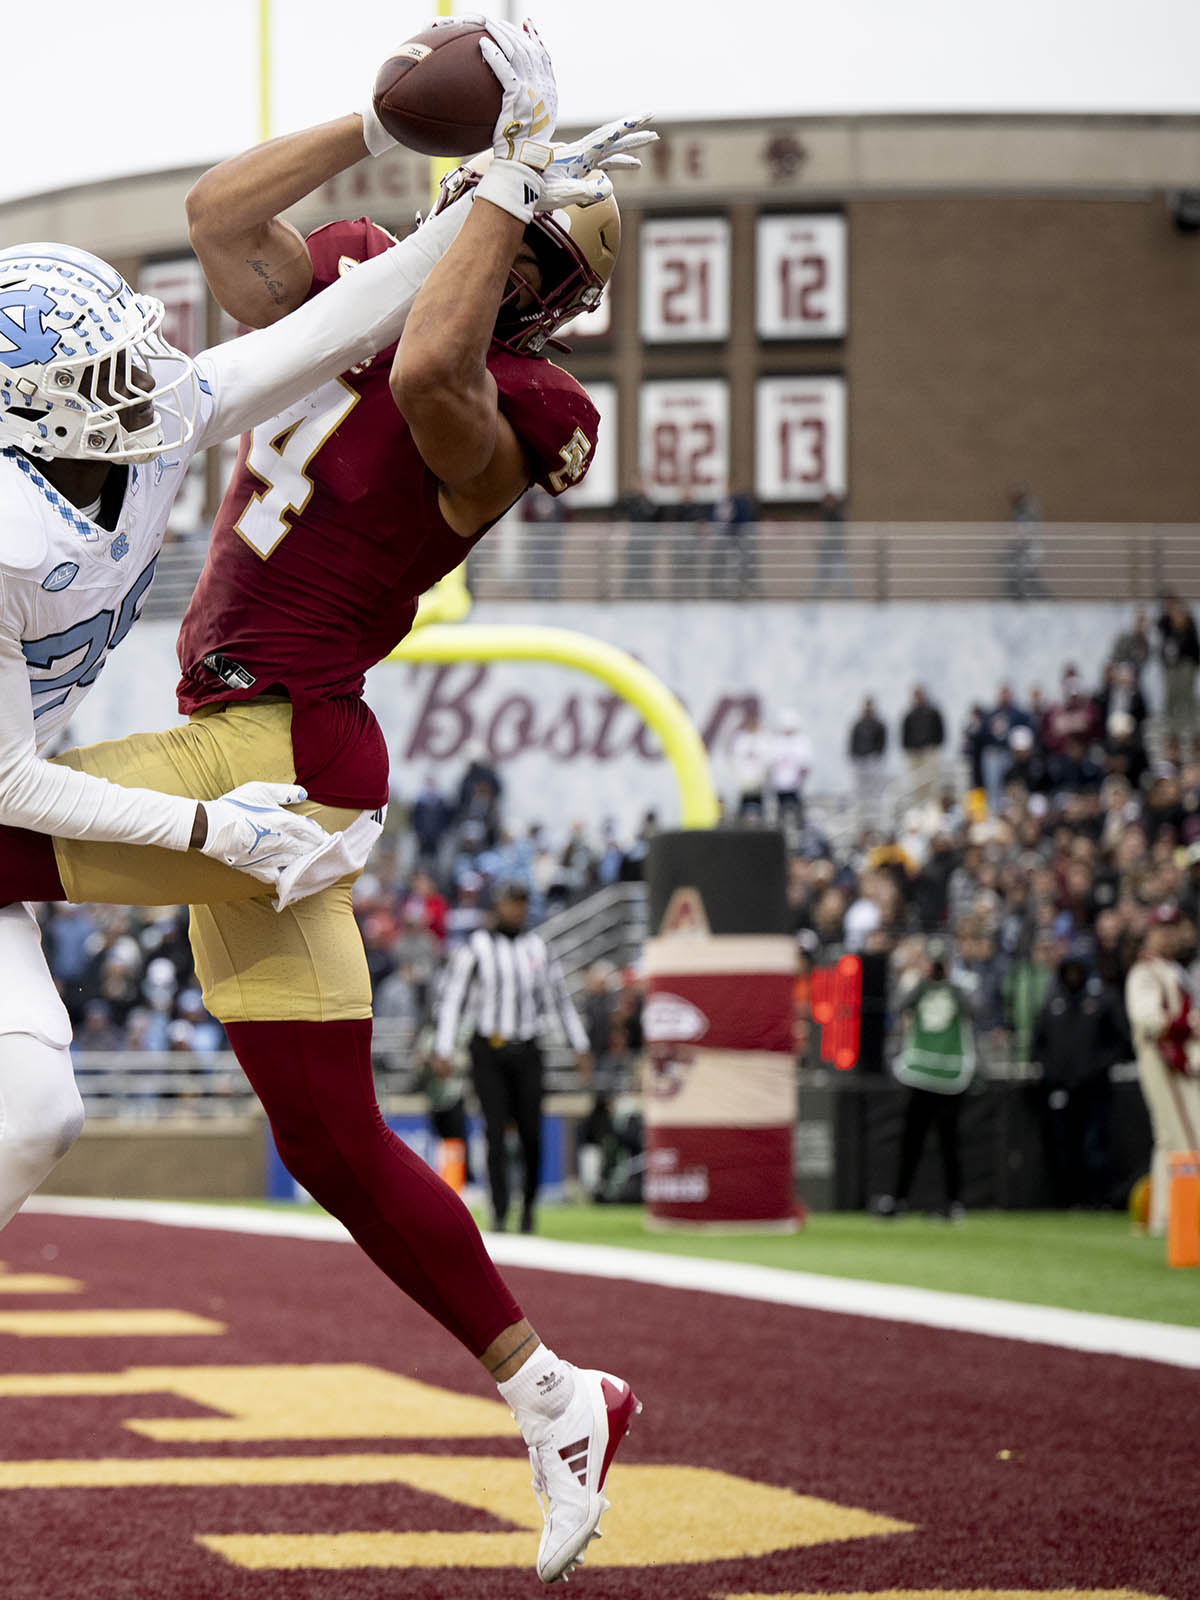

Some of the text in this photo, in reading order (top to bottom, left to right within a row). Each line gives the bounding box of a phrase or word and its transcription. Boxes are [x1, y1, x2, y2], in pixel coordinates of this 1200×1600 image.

[663, 259, 709, 325] 21
[780, 256, 827, 321] 12
[233, 376, 361, 561] 4
[655, 422, 715, 485] 82
[780, 418, 825, 483] 13
